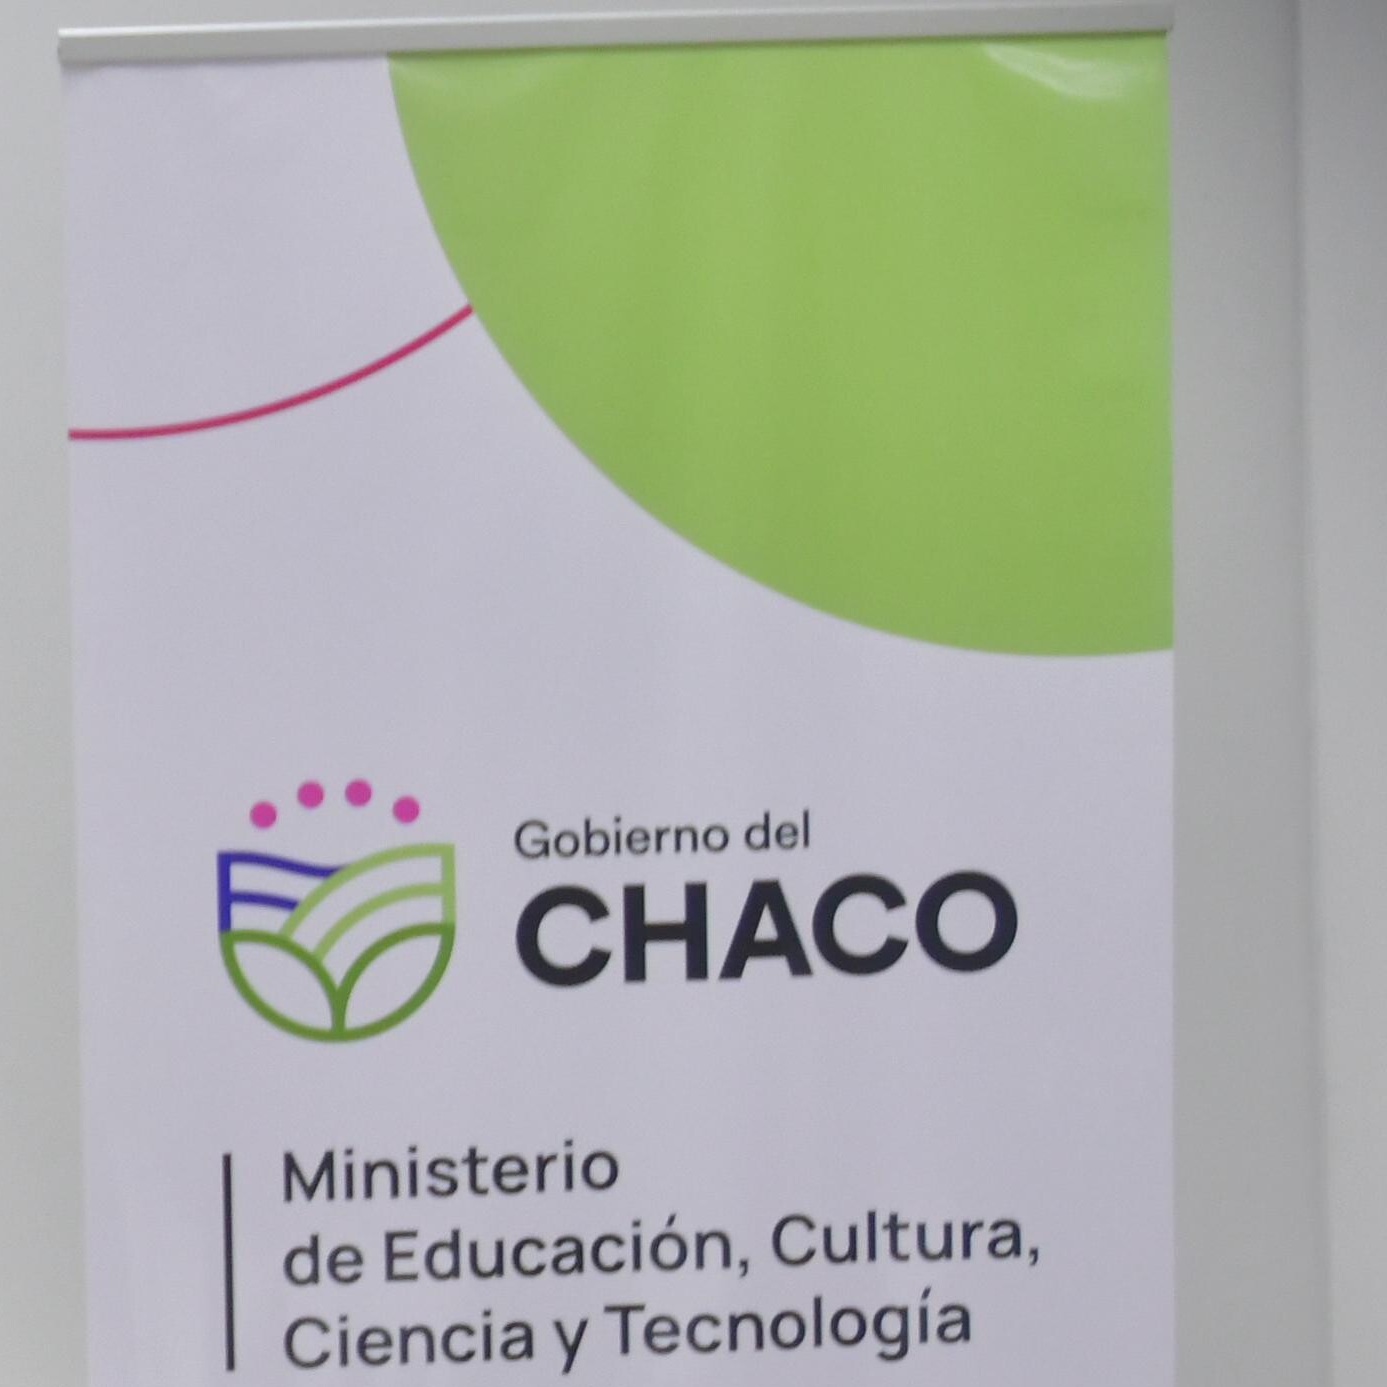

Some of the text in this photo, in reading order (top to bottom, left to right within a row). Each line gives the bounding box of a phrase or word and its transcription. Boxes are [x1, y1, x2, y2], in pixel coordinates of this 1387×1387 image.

[513, 809, 811, 860] Gobierno del
[515, 869, 1019, 989] CHACO
[282, 1138, 620, 1203] Ministerio
[282, 1209, 1040, 1287] de Educación, Cultura,
[283, 1288, 972, 1375] Ciencia y Tecnología
